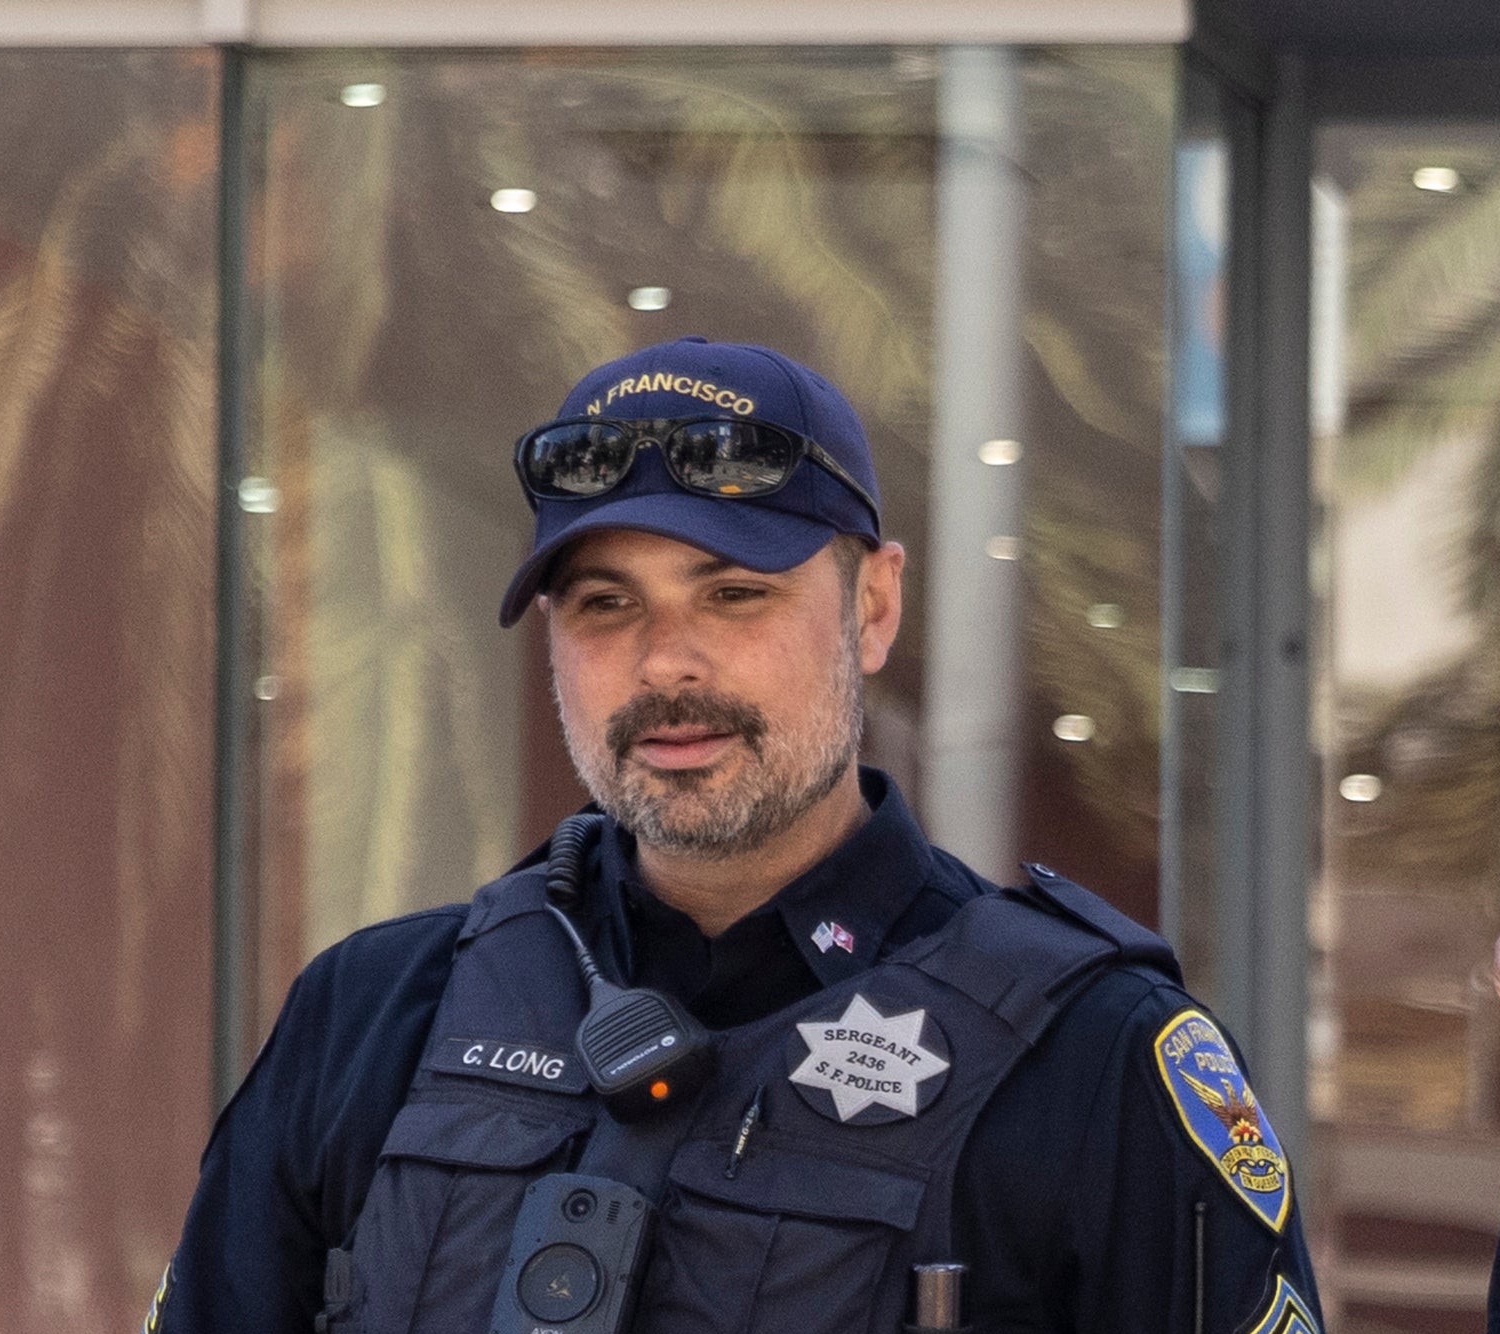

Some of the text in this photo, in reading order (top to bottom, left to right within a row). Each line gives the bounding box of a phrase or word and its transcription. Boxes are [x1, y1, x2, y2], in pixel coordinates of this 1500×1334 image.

[606, 373, 755, 416] FRANCISCO
[462, 1045, 565, 1080] C. LONG
[823, 1029, 922, 1067] SERGEANT
[846, 1051, 887, 1072] 2436
[815, 1061, 903, 1095] S. F. POLICE
